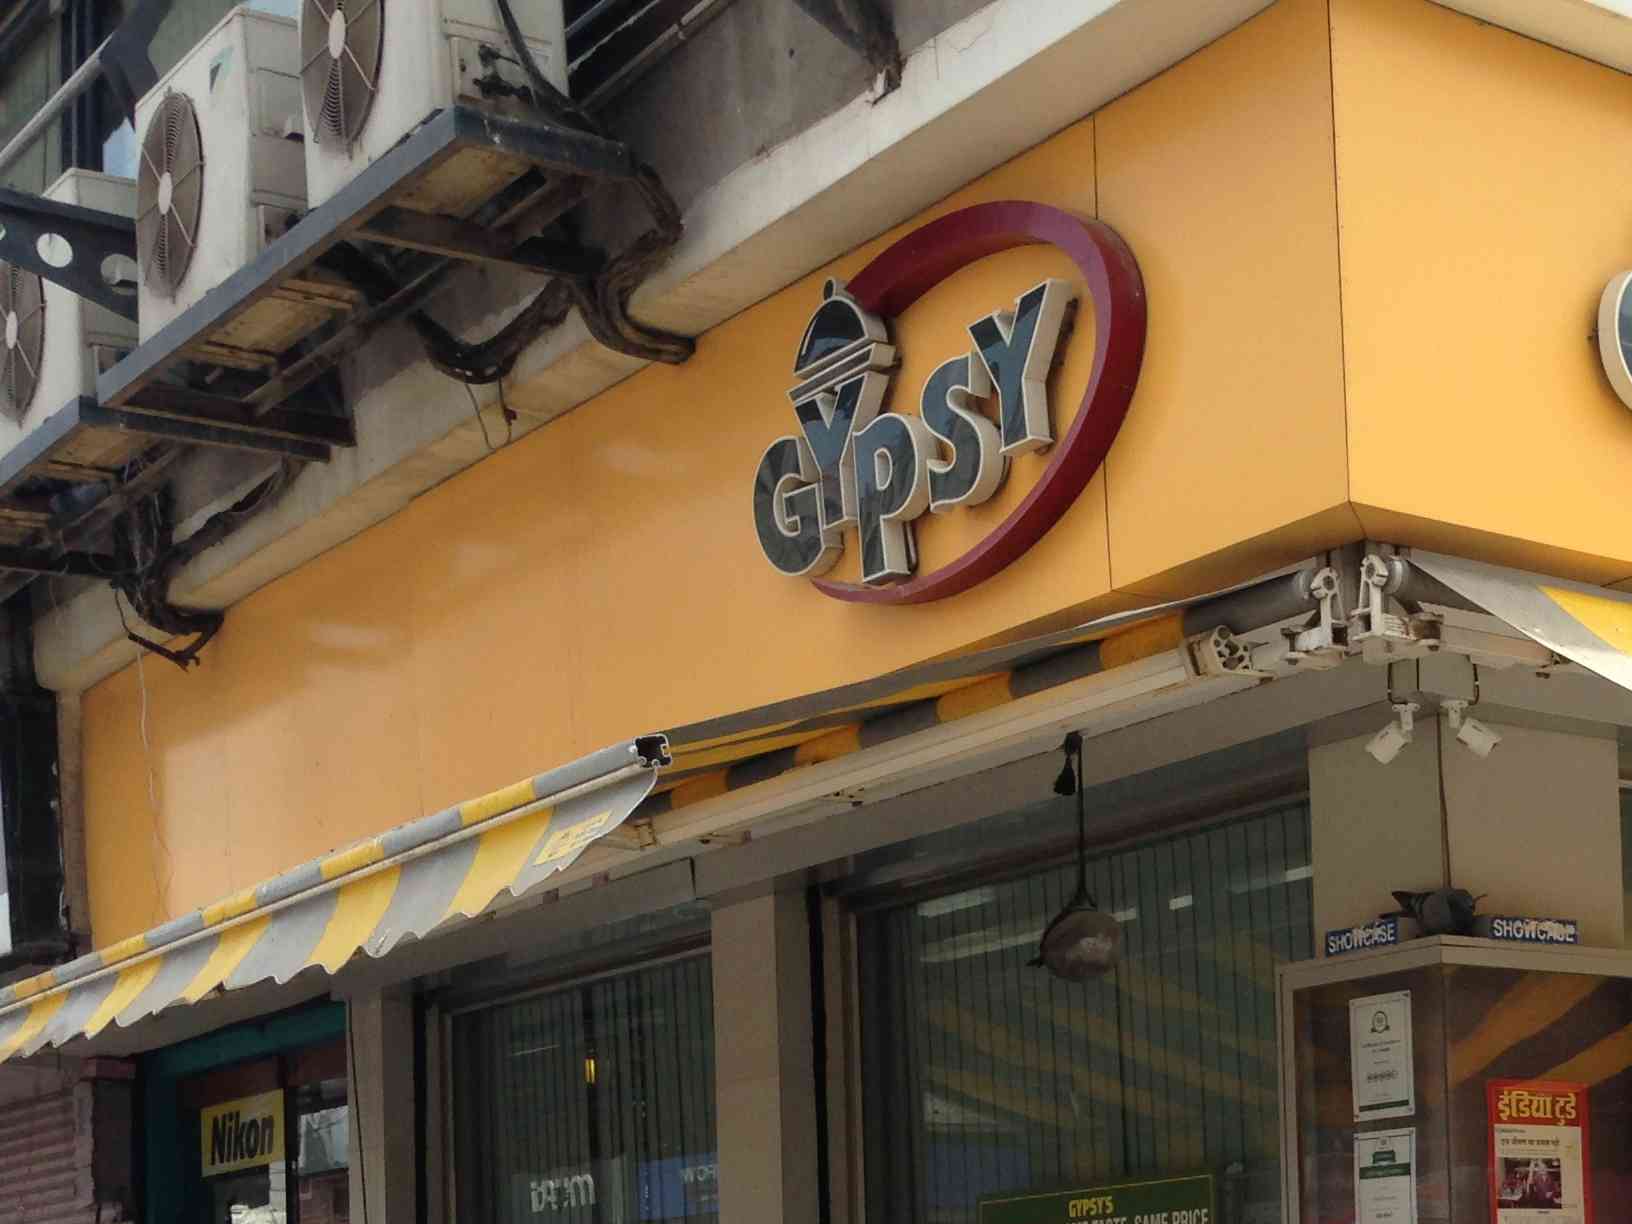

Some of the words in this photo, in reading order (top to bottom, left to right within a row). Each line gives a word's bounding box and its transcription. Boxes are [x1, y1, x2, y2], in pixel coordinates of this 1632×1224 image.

[752, 278, 1076, 584] GYPSY
[1497, 1090, 1552, 1120] इंडिया
[1555, 1092, 1577, 1126] टुडे
[210, 1111, 274, 1166] Nikon
